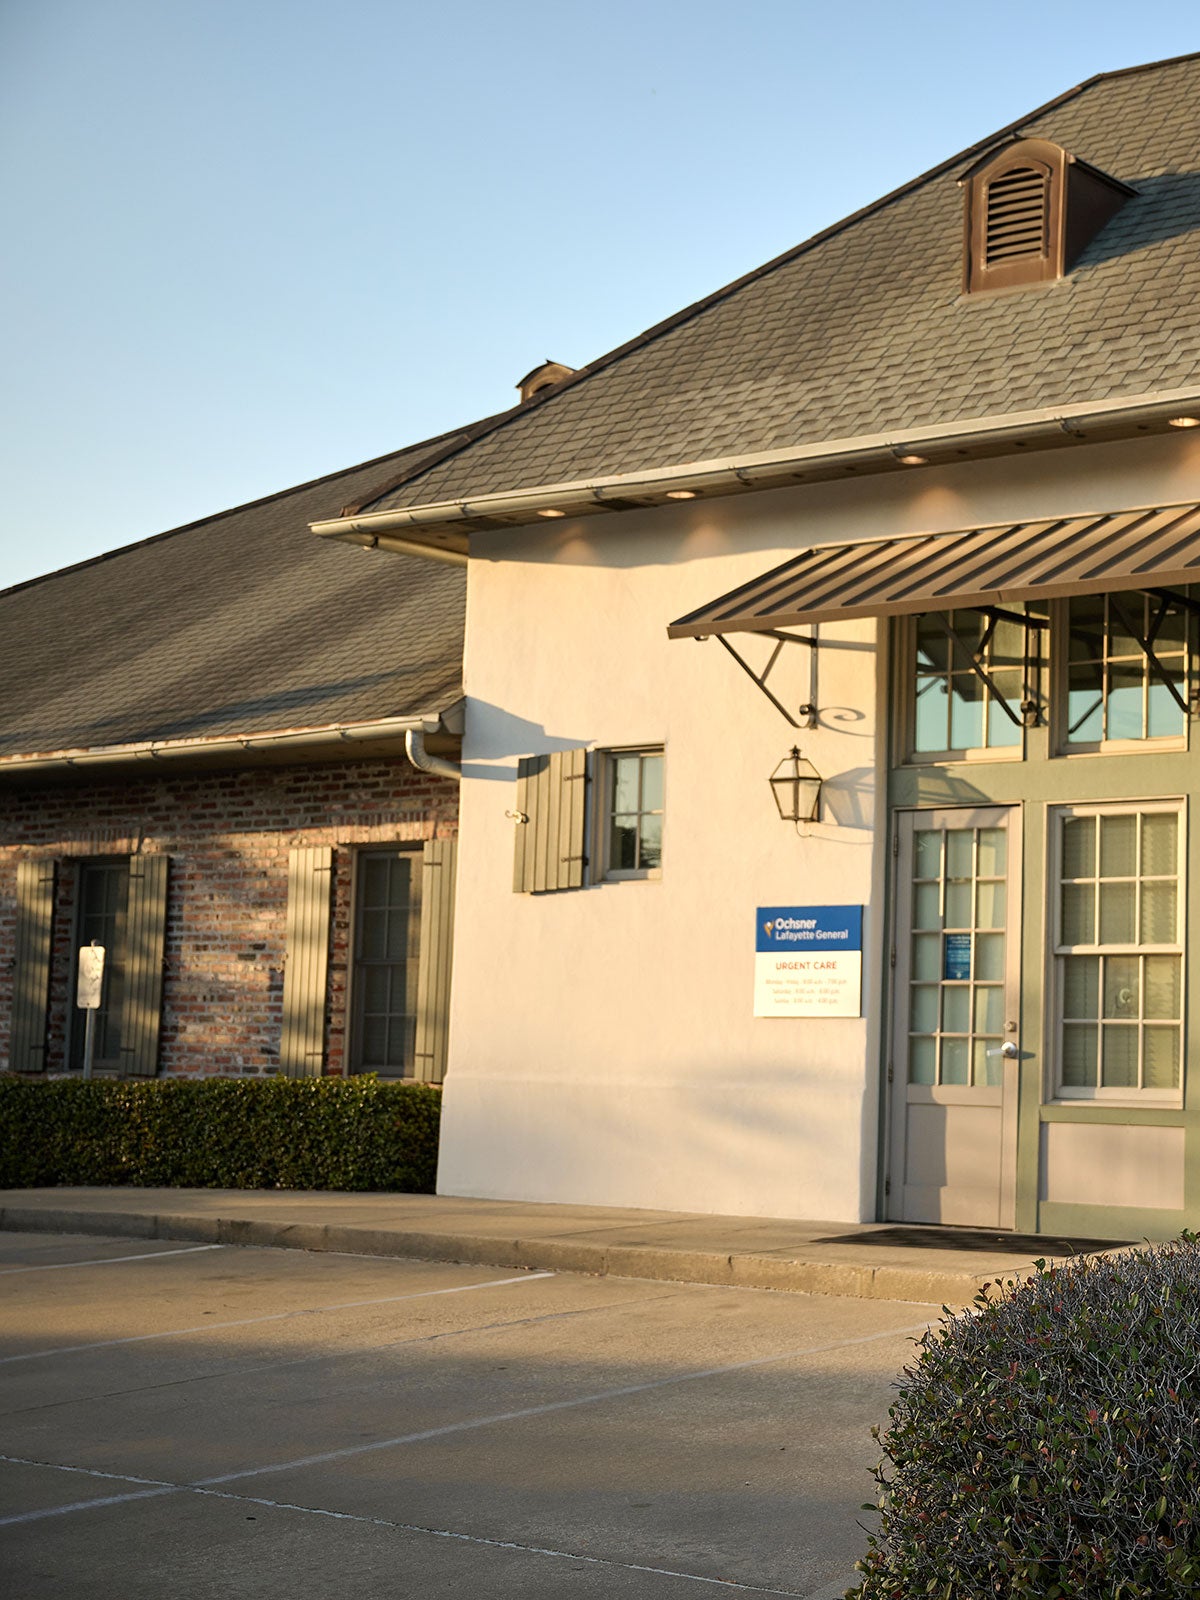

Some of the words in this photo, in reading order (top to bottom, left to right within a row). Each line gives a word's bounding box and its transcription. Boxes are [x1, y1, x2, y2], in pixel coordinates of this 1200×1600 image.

[775, 917, 818, 930] Ochsner
[775, 930, 815, 942] Lafayette
[815, 929, 849, 940] General
[775, 961, 811, 971] URGENT
[813, 960, 838, 970] CARE
